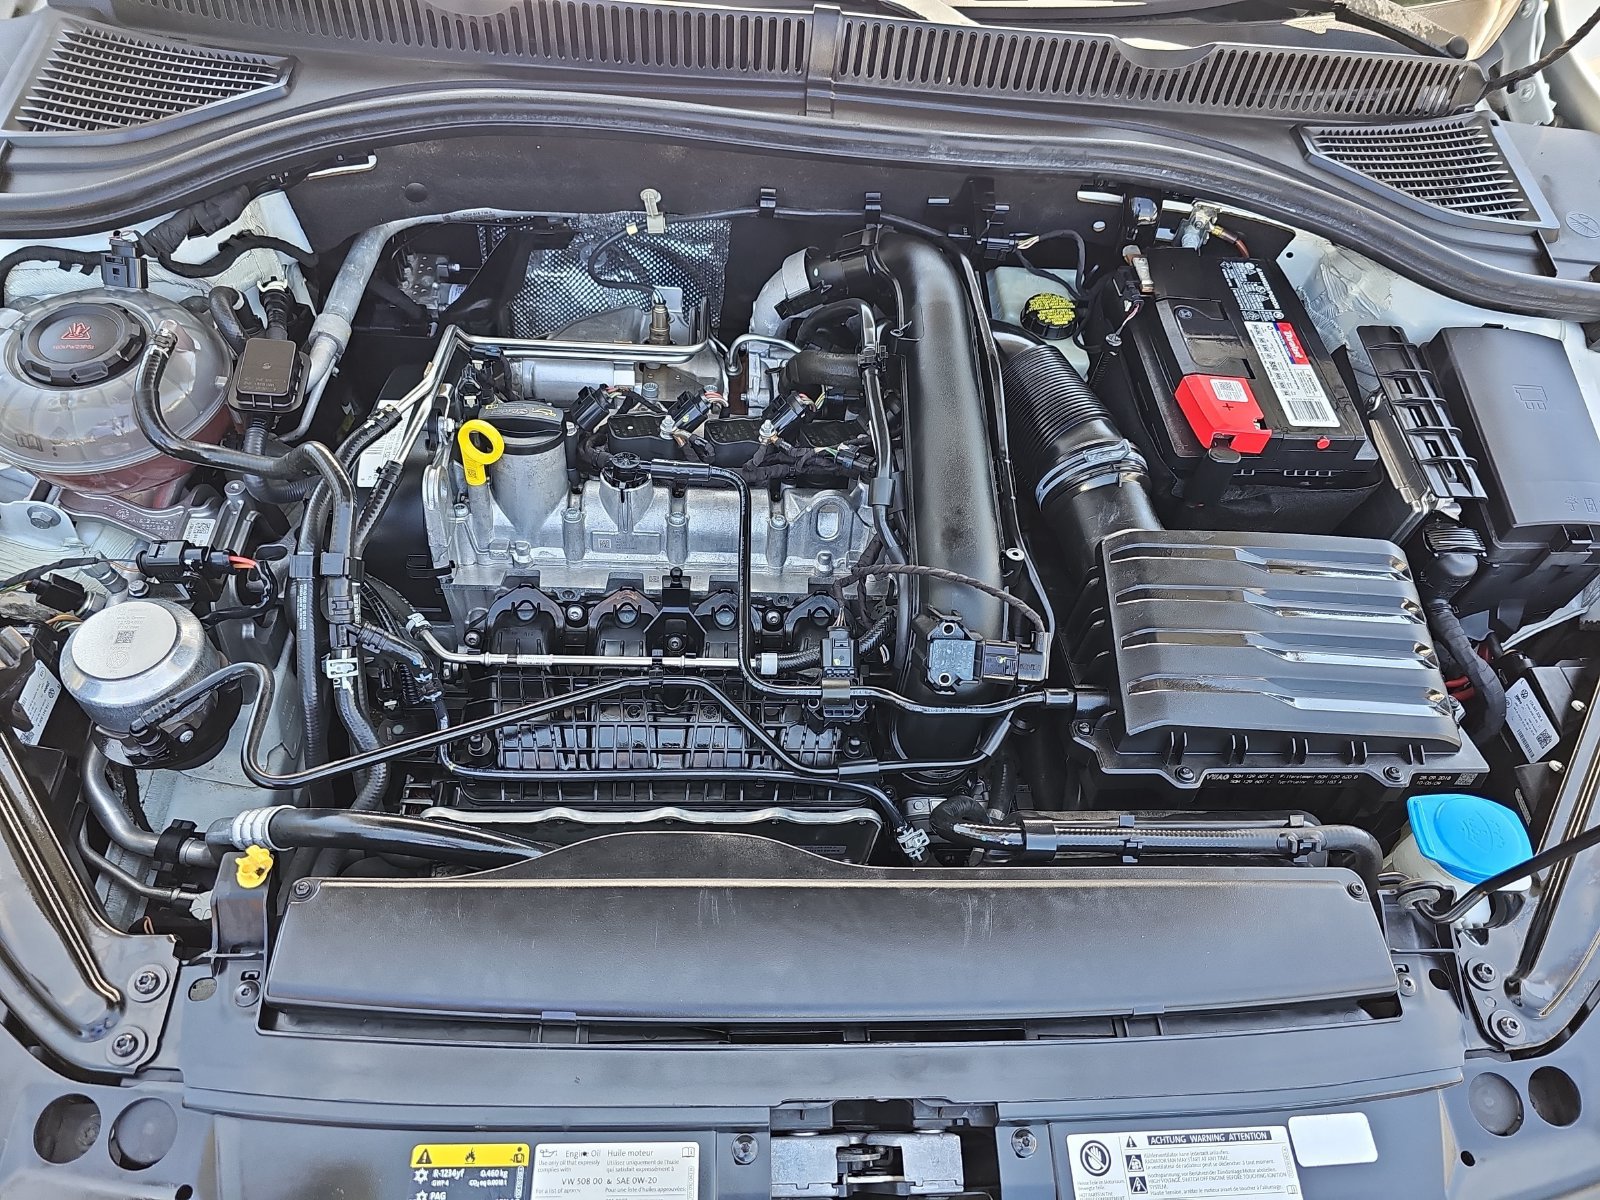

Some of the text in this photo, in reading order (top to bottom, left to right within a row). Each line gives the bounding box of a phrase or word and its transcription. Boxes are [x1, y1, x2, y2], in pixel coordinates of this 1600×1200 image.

[1283, 330, 1304, 358] Duralast
[1151, 1132, 1267, 1144] ACHTUNG WARNING ATTENTION
[432, 1169, 464, 1179] R-1234yf
[429, 1192, 446, 1200] PAG
